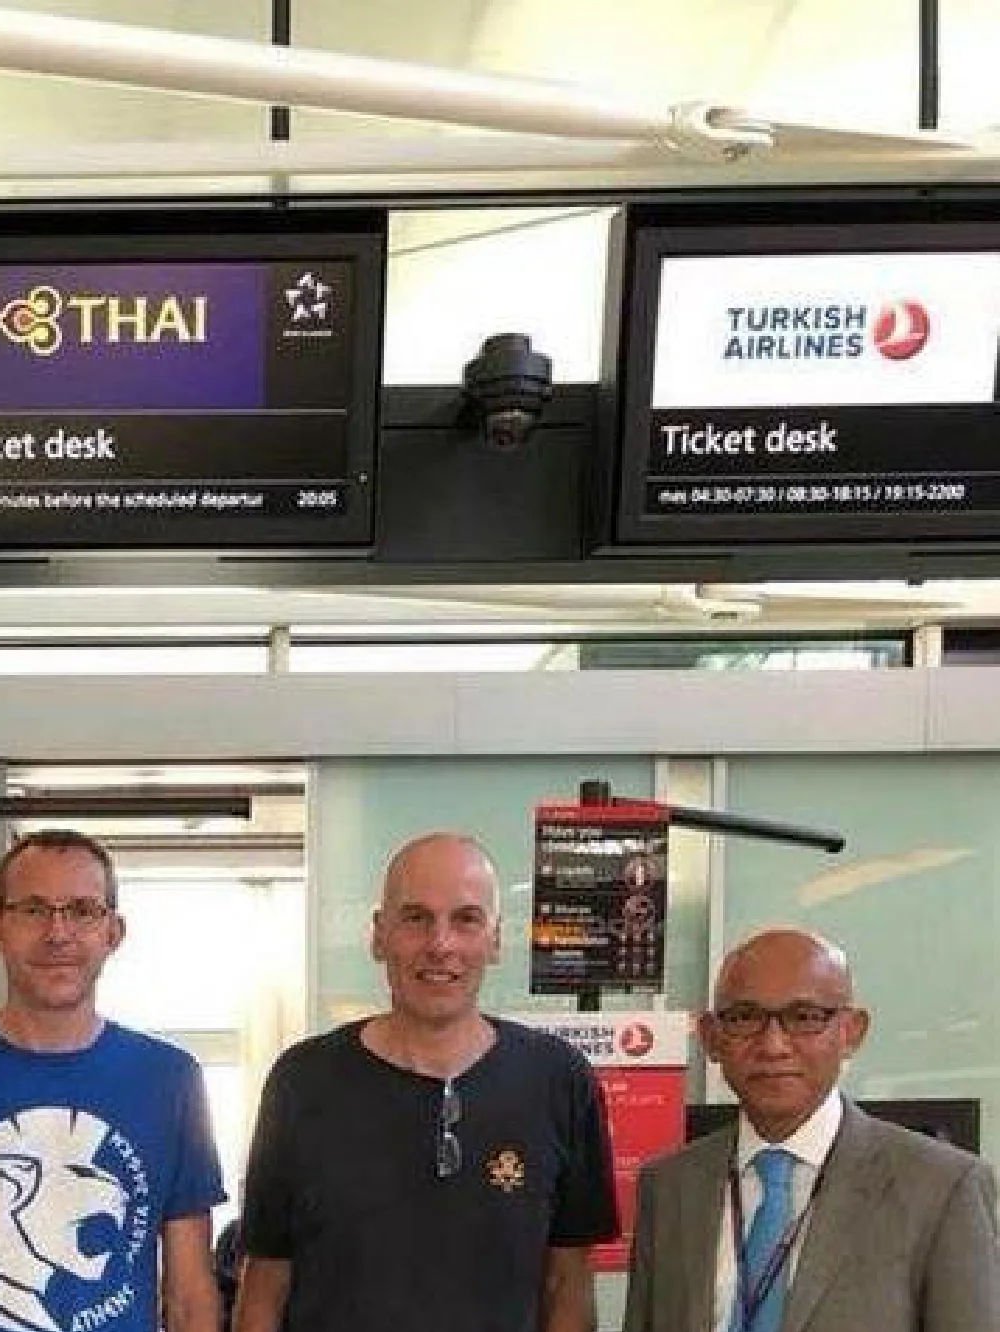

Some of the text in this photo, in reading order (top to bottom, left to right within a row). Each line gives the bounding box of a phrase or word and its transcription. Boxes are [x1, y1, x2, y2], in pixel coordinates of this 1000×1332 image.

[68, 296, 208, 343] THAI
[726, 305, 867, 331] TURKISH
[723, 333, 864, 359] AIRLINES
[43, 428, 117, 460] desk
[660, 420, 838, 454] Ticket desk
[44, 491, 93, 508] before
[97, 491, 121, 507] the
[124, 491, 197, 508] scheduled
